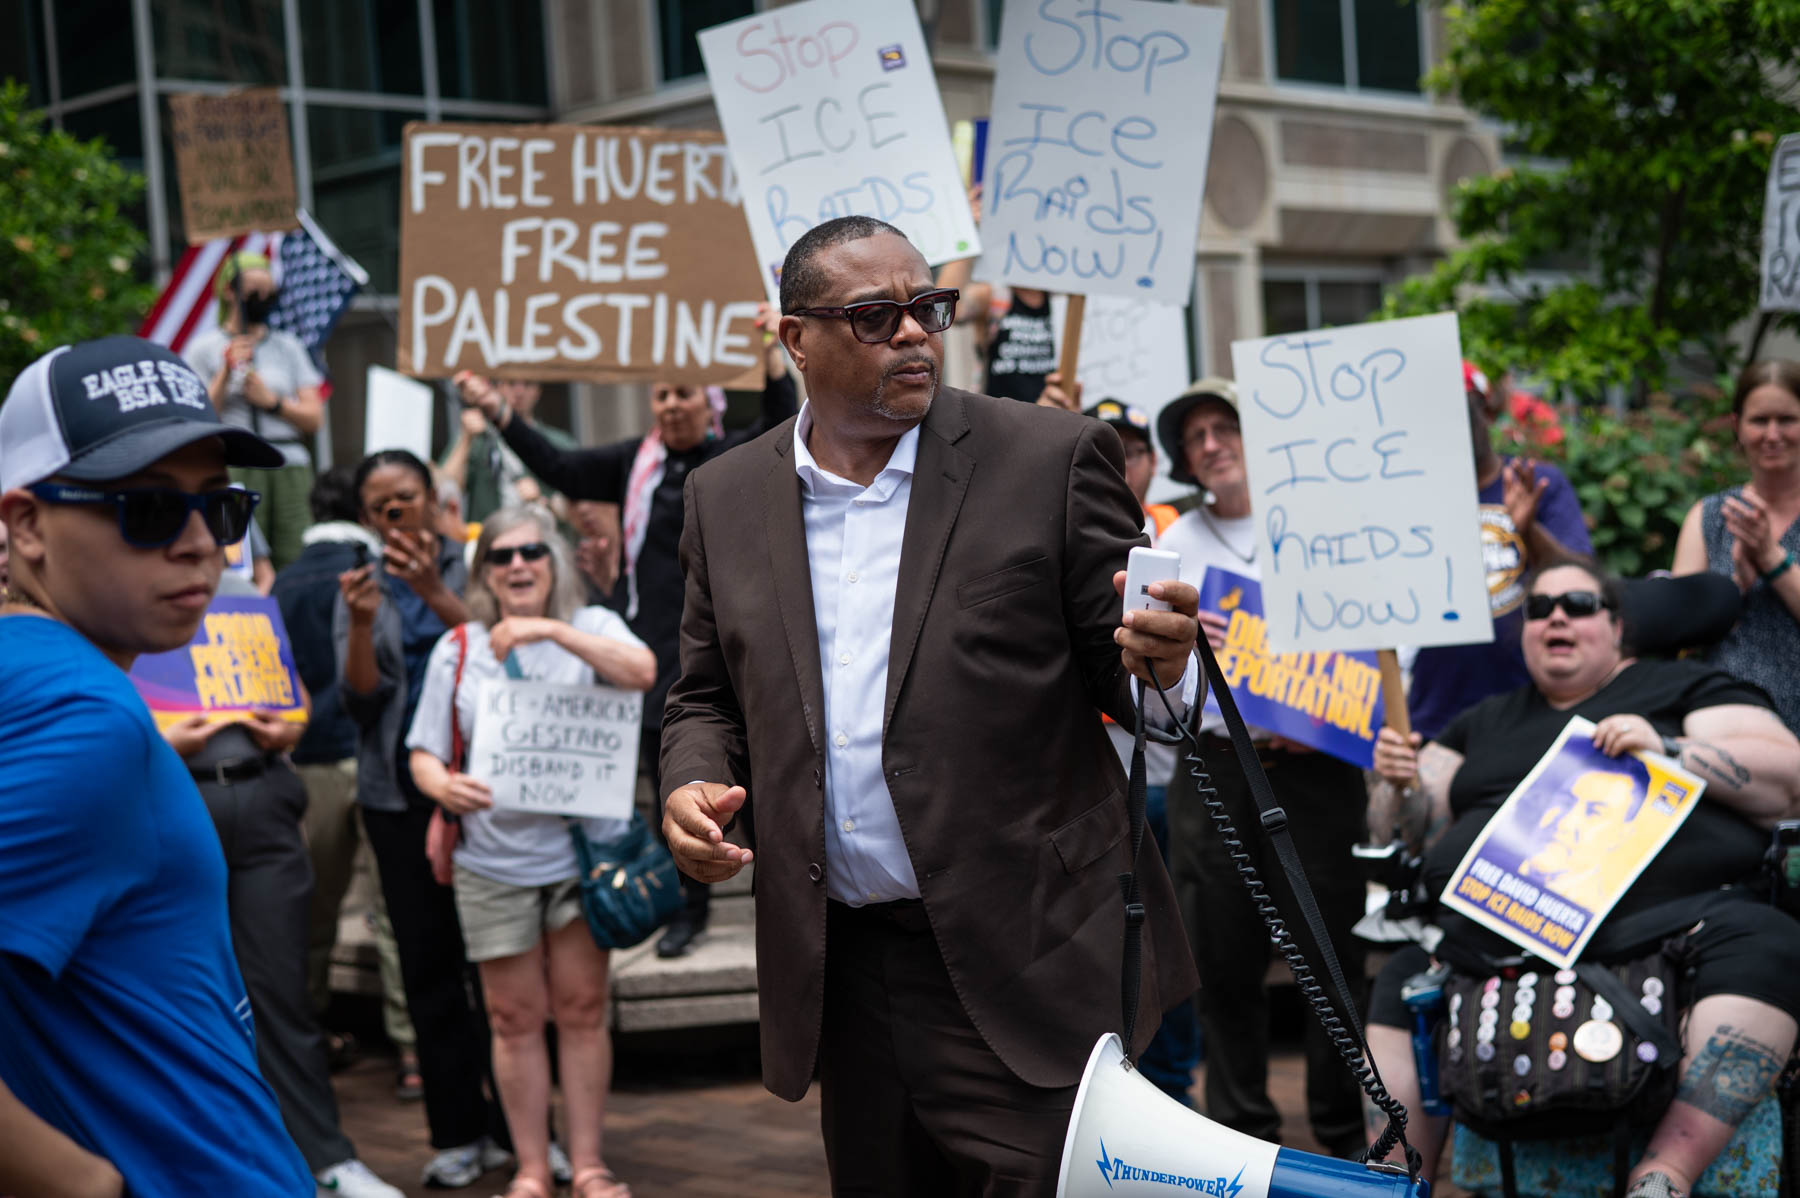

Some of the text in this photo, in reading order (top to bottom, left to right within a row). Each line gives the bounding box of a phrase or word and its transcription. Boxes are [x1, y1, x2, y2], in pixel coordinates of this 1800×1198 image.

[758, 81, 908, 176] ICE
[410, 132, 556, 214] FREE
[501, 217, 669, 286] FREE
[412, 275, 762, 374] PALESTINE
[81, 360, 159, 400] EAGLE
[114, 382, 168, 412] BSA
[1264, 430, 1425, 495] ICE
[489, 752, 585, 781] DISBAND
[518, 782, 581, 806] NOW
[1112, 1157, 1227, 1198] THUNDERPOWER
